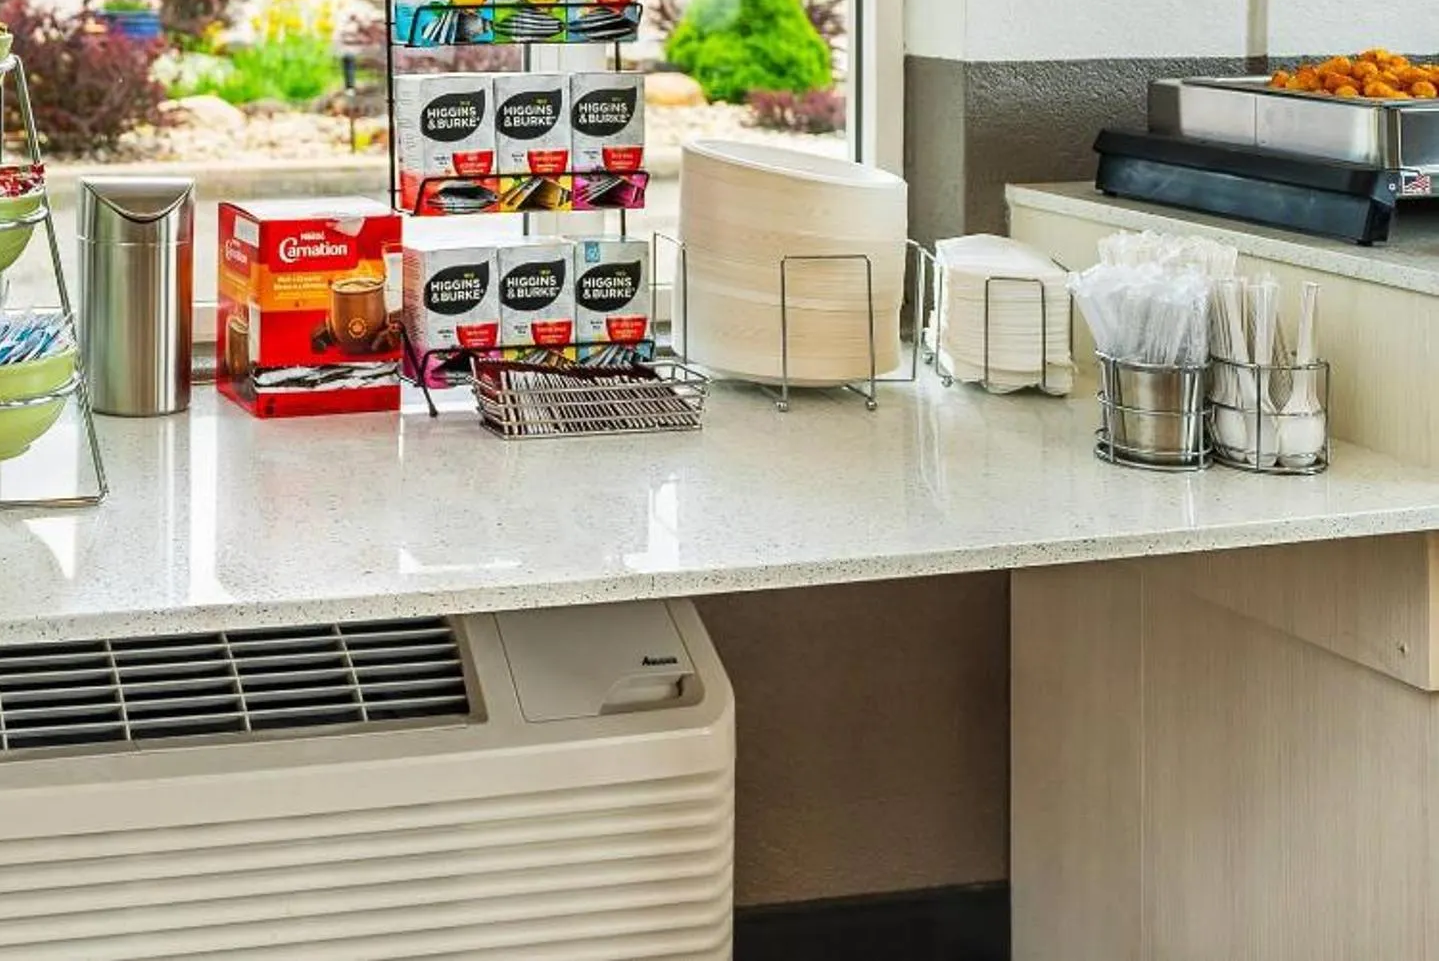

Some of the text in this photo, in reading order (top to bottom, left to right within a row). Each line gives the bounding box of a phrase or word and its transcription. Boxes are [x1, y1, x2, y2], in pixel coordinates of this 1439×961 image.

[427, 106, 476, 118] HIGGINS
[503, 104, 553, 115] HIGGINS
[578, 102, 628, 113] HIGGINS
[279, 237, 348, 263] Carnation
[431, 279, 480, 291] HIGGINS
[507, 275, 557, 287] HIGGINS
[583, 277, 632, 288] HIGGINS
